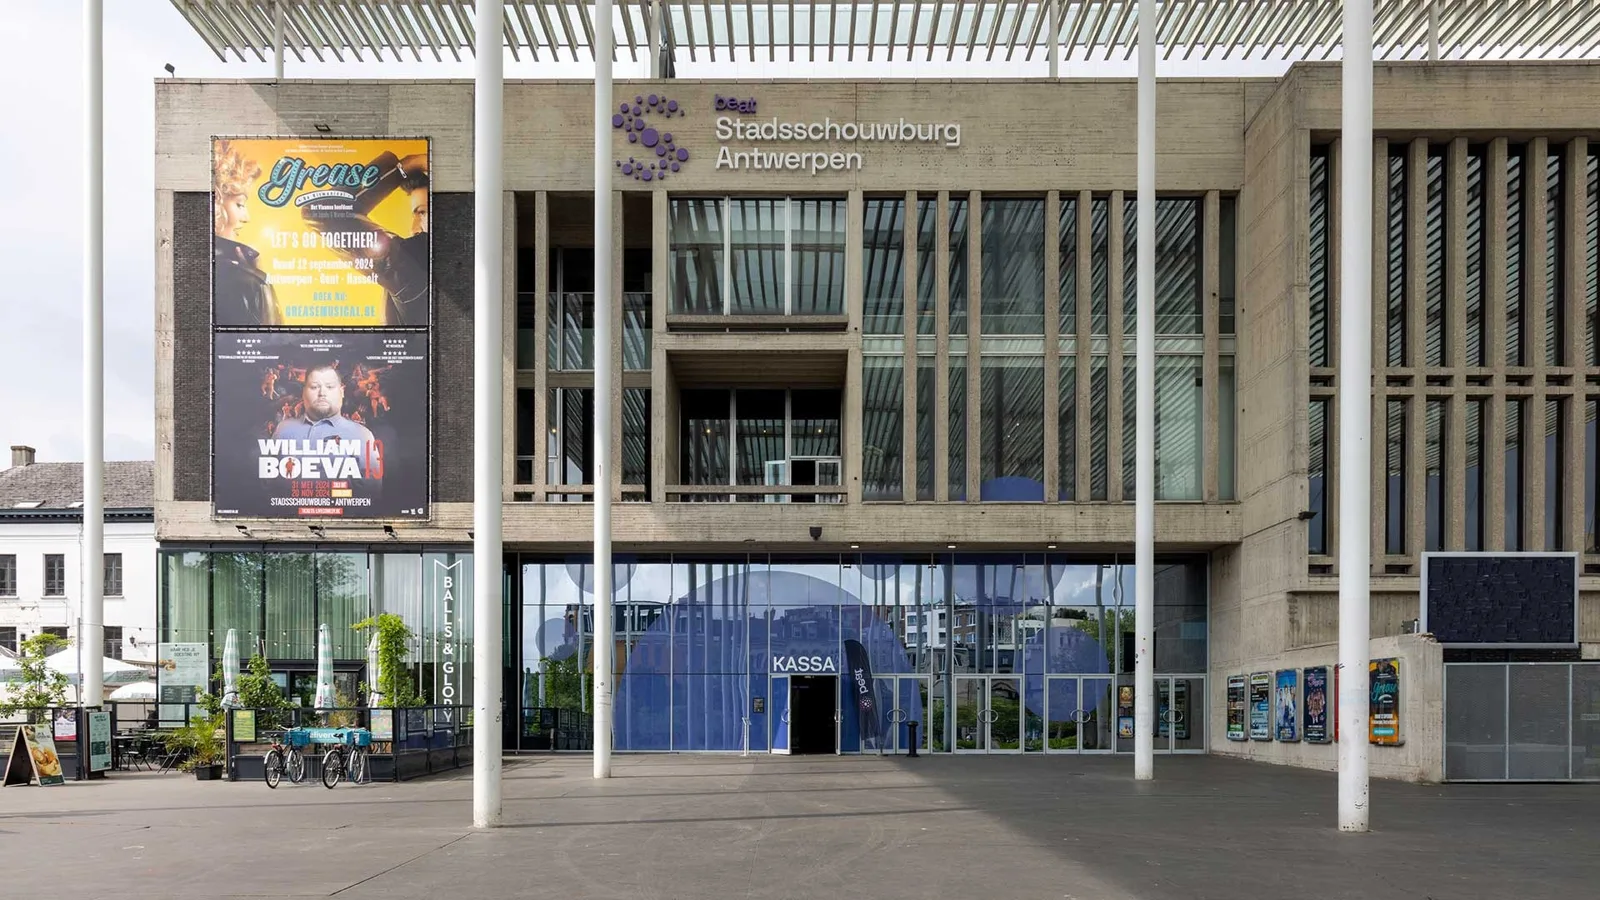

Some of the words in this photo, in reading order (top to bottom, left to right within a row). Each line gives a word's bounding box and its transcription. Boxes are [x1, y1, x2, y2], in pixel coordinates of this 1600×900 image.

[715, 94, 756, 114] beat
[715, 117, 961, 147] Stadsschouwburg
[715, 146, 862, 175] Antwerpen
[258, 156, 381, 207] grease
[271, 232, 299, 249] LET'S
[302, 232, 317, 249] GO
[320, 231, 379, 249] TOGETHER!
[309, 259, 353, 273] september
[354, 258, 374, 270] 2024
[265, 273, 312, 286] Antwerpen
[346, 272, 379, 285] Hasselt
[258, 439, 361, 456] WILLIAM
[258, 456, 362, 479] BOEVA
[301, 481, 314, 489] MEI
[315, 481, 330, 489] 2024
[301, 489, 314, 497] NOV
[315, 489, 330, 497] 2024
[270, 497, 331, 506] STADSSCHOUWBURG
[335, 497, 371, 506] ANTWERPEN
[443, 576, 453, 638] BALLS
[442, 642, 454, 655] &
[773, 656, 836, 672] KASSA
